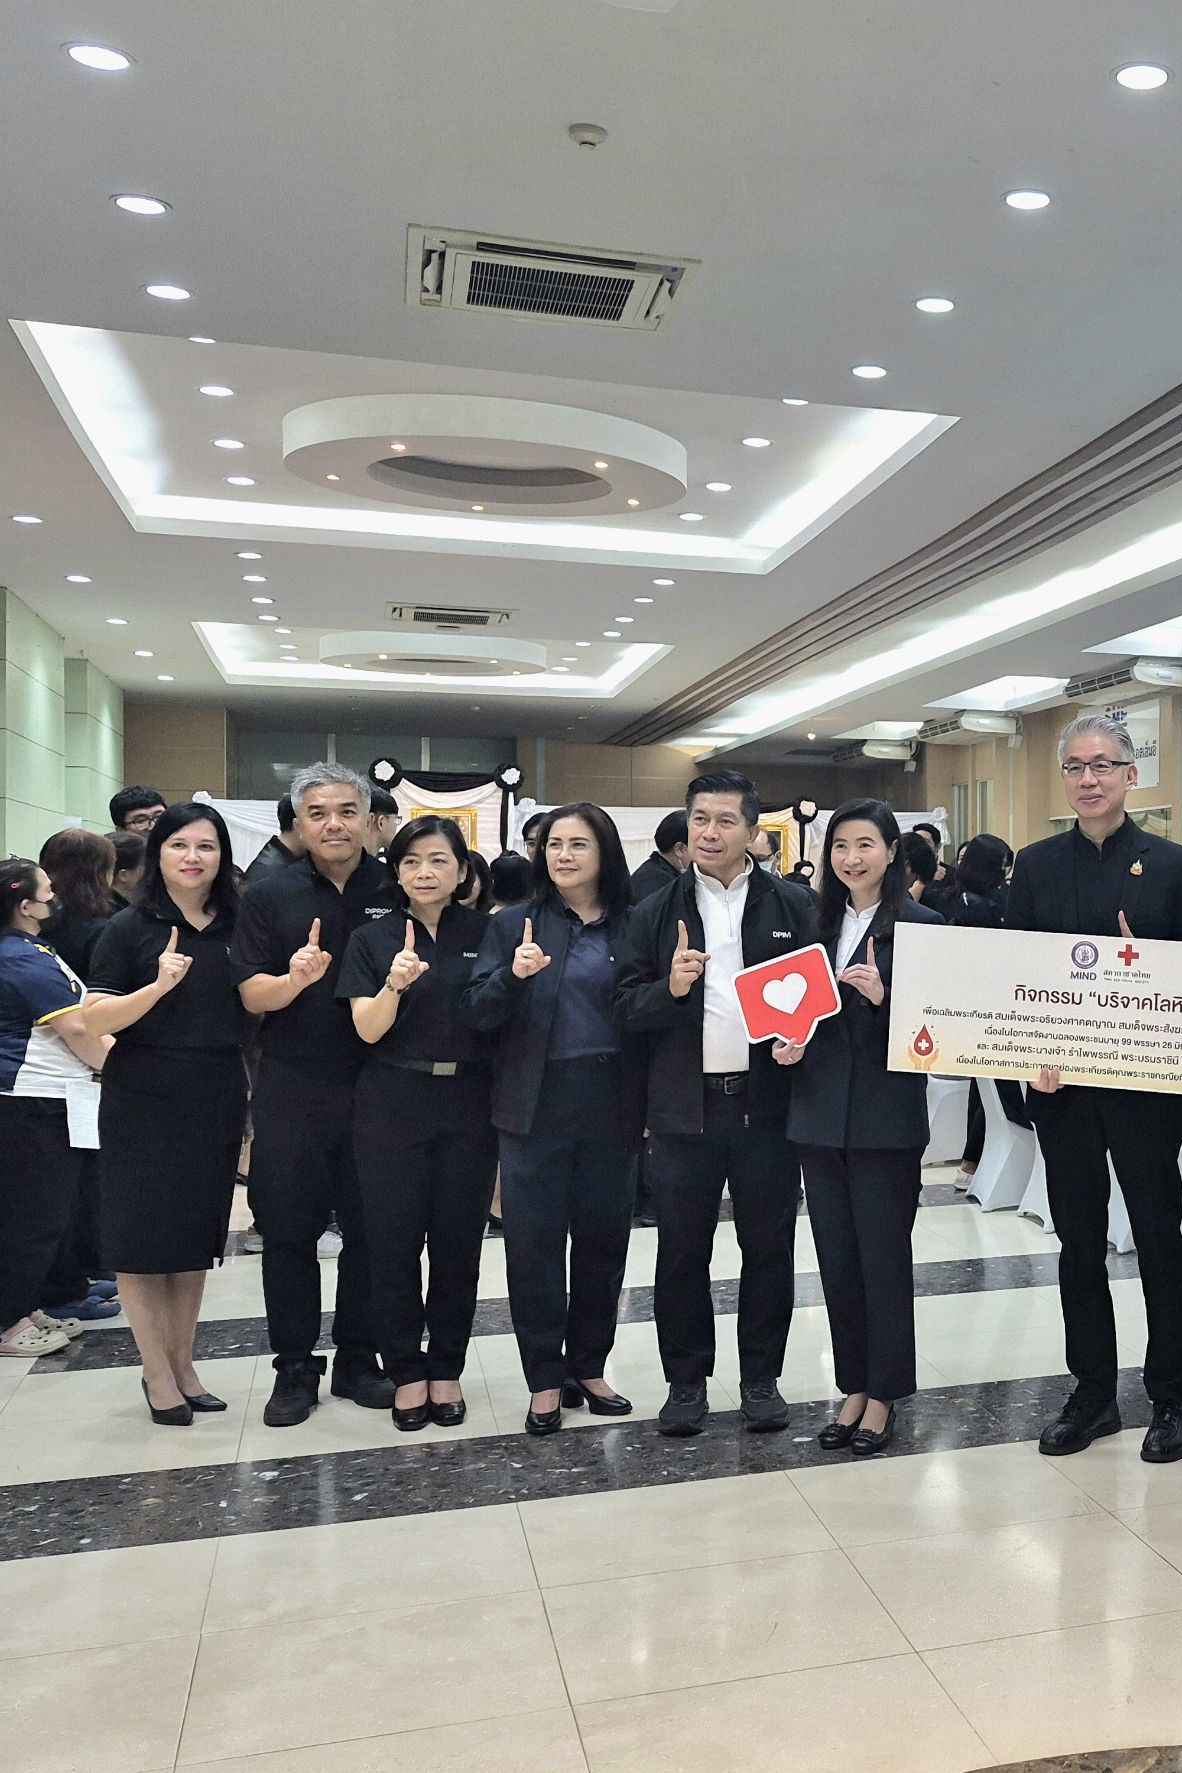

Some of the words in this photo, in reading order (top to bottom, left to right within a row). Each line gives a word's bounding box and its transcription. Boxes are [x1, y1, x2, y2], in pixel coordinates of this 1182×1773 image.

[1070, 971, 1097, 981] MIND
[1014, 984, 1083, 1006] กิจกรรม
[976, 1043, 990, 1051] และ
[1121, 1038, 1132, 1046] 99
[1133, 1039, 1161, 1049] พรรษา
[1162, 1041, 1173, 1049] 26
